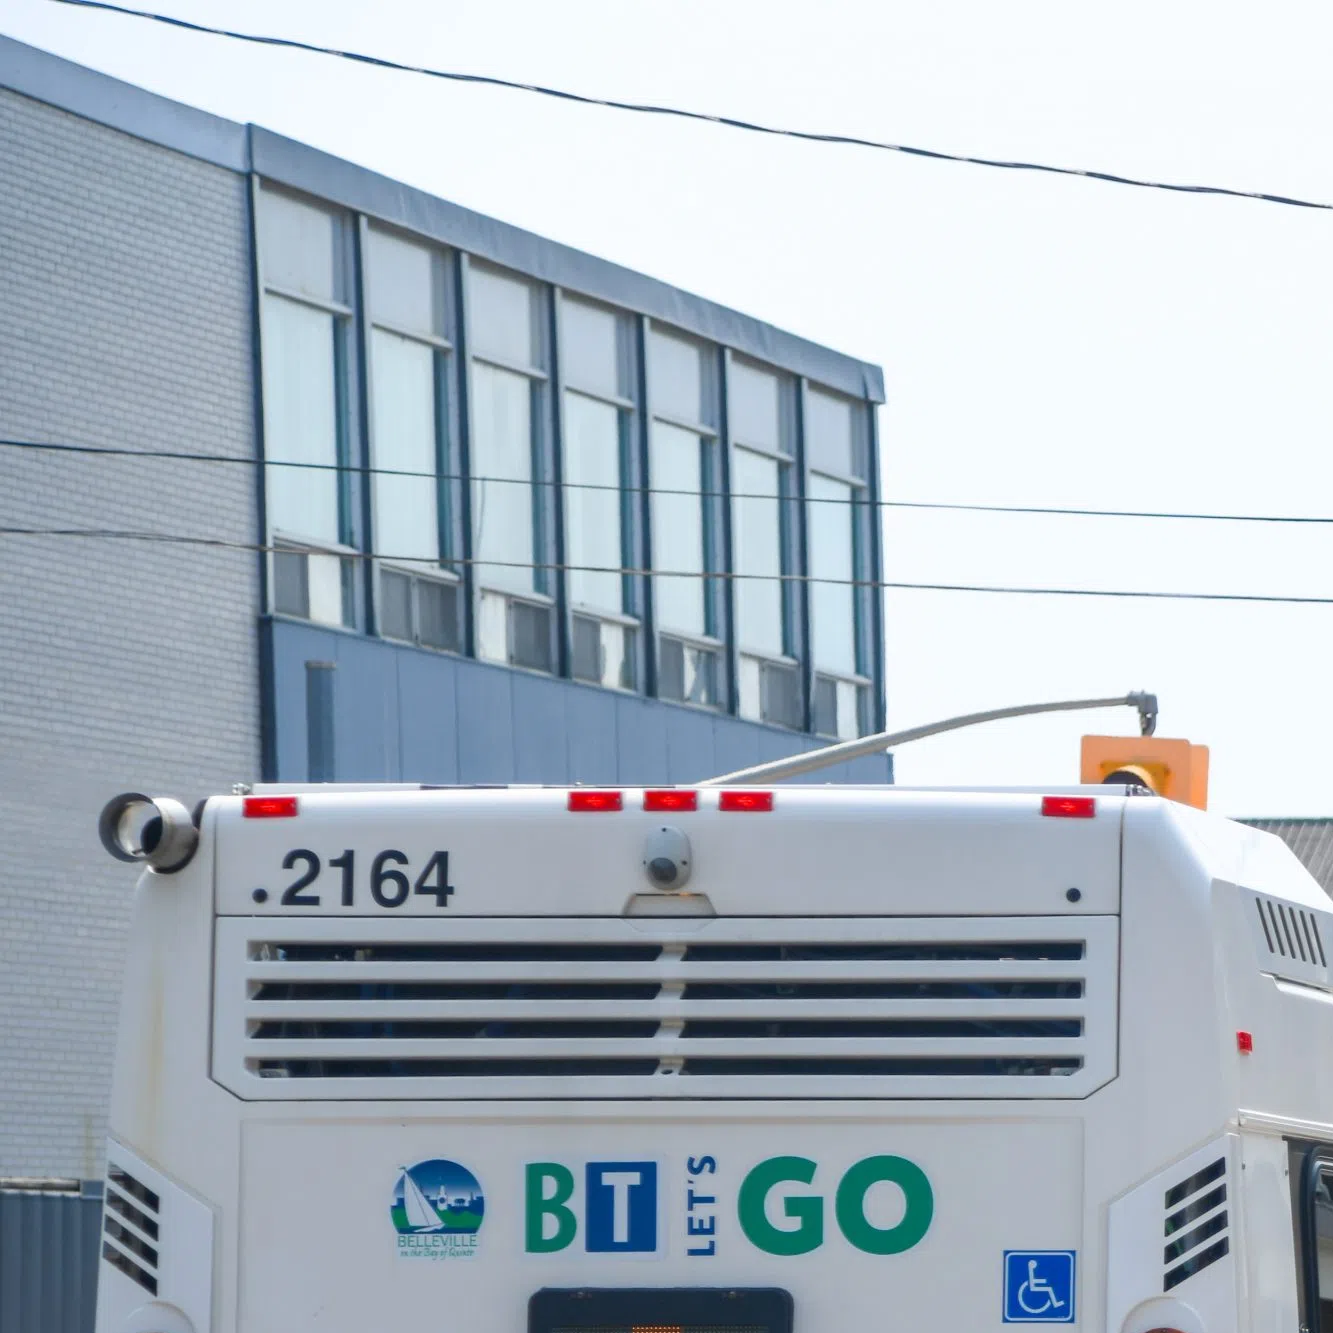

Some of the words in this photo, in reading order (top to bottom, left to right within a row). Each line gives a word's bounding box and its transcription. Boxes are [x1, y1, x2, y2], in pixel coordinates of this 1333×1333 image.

[281, 849, 455, 908] 2164
[524, 1161, 658, 1253] BT
[687, 1154, 717, 1257] LET'S
[737, 1154, 935, 1257] GO
[397, 1235, 478, 1247] BELLEVILLE
